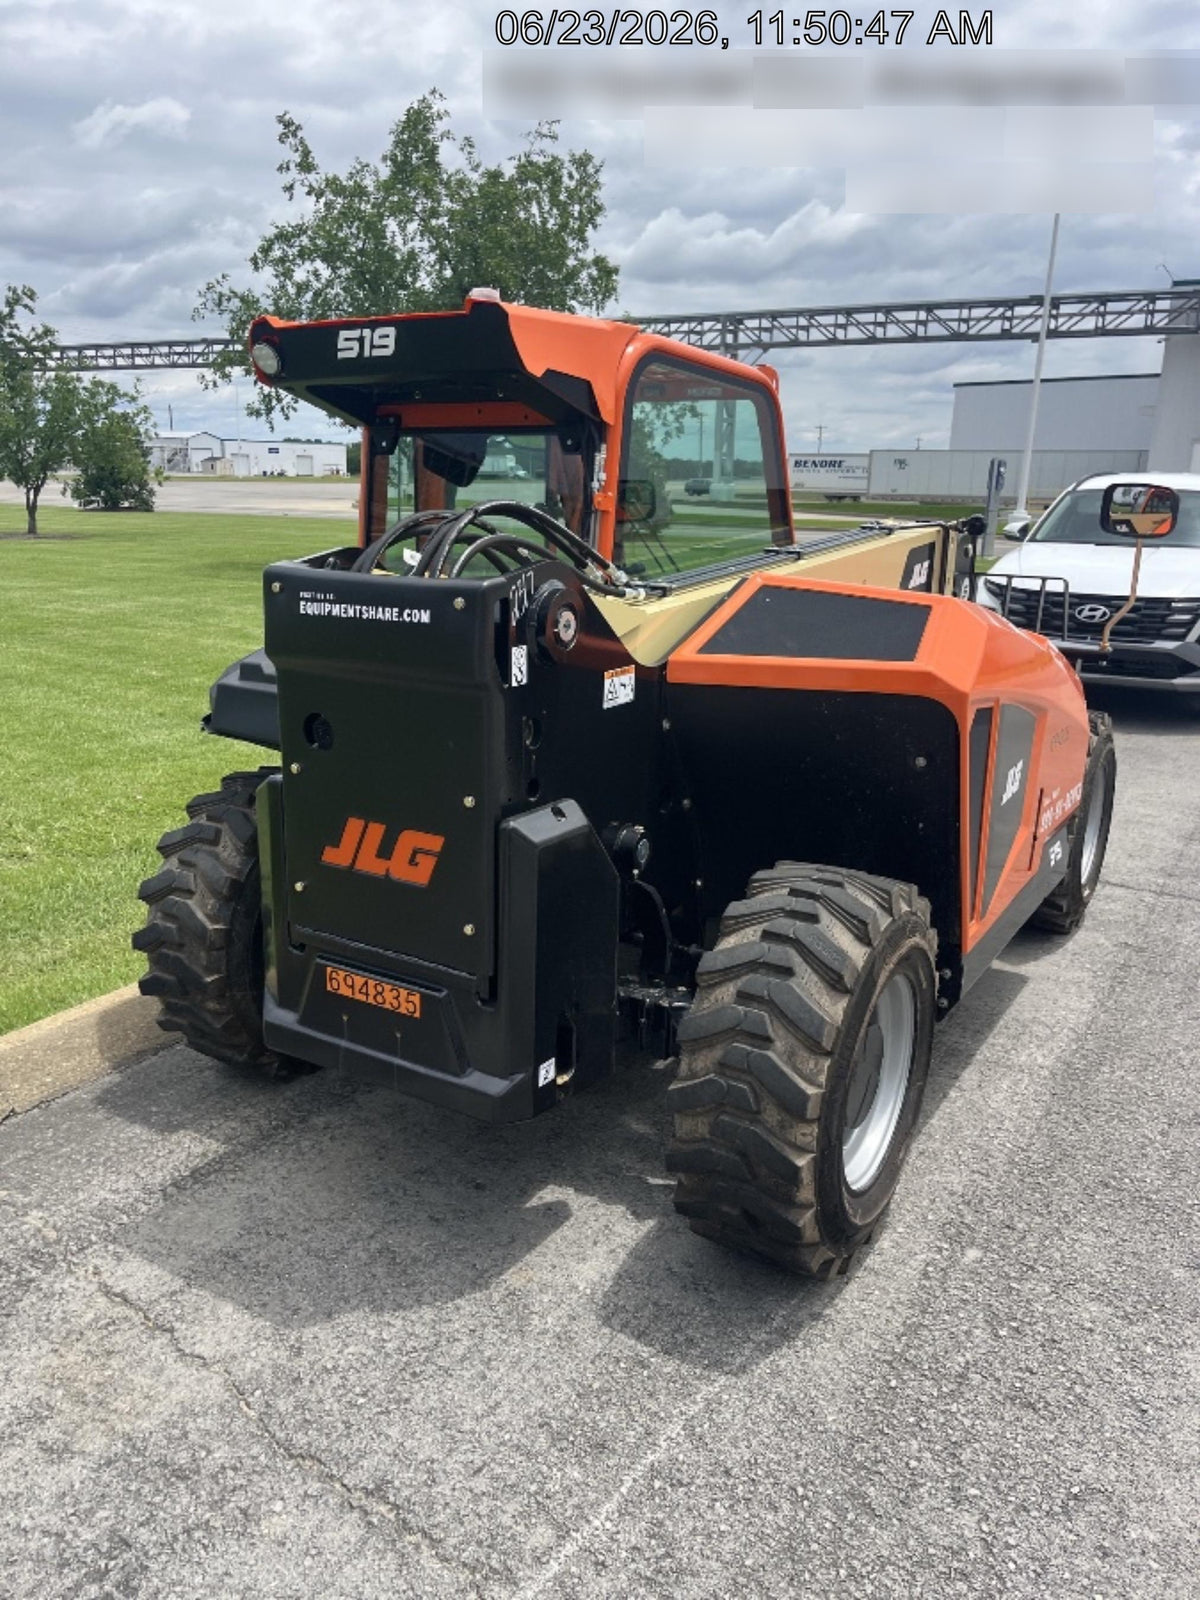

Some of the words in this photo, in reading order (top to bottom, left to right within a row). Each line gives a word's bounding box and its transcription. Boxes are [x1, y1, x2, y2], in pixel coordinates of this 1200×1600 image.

[337, 327, 397, 360] 519
[794, 459, 846, 469] BENORE
[299, 600, 431, 623] EQUIPMENTSHARE.COM
[321, 816, 446, 887] JLG
[328, 969, 418, 1016] 694835
